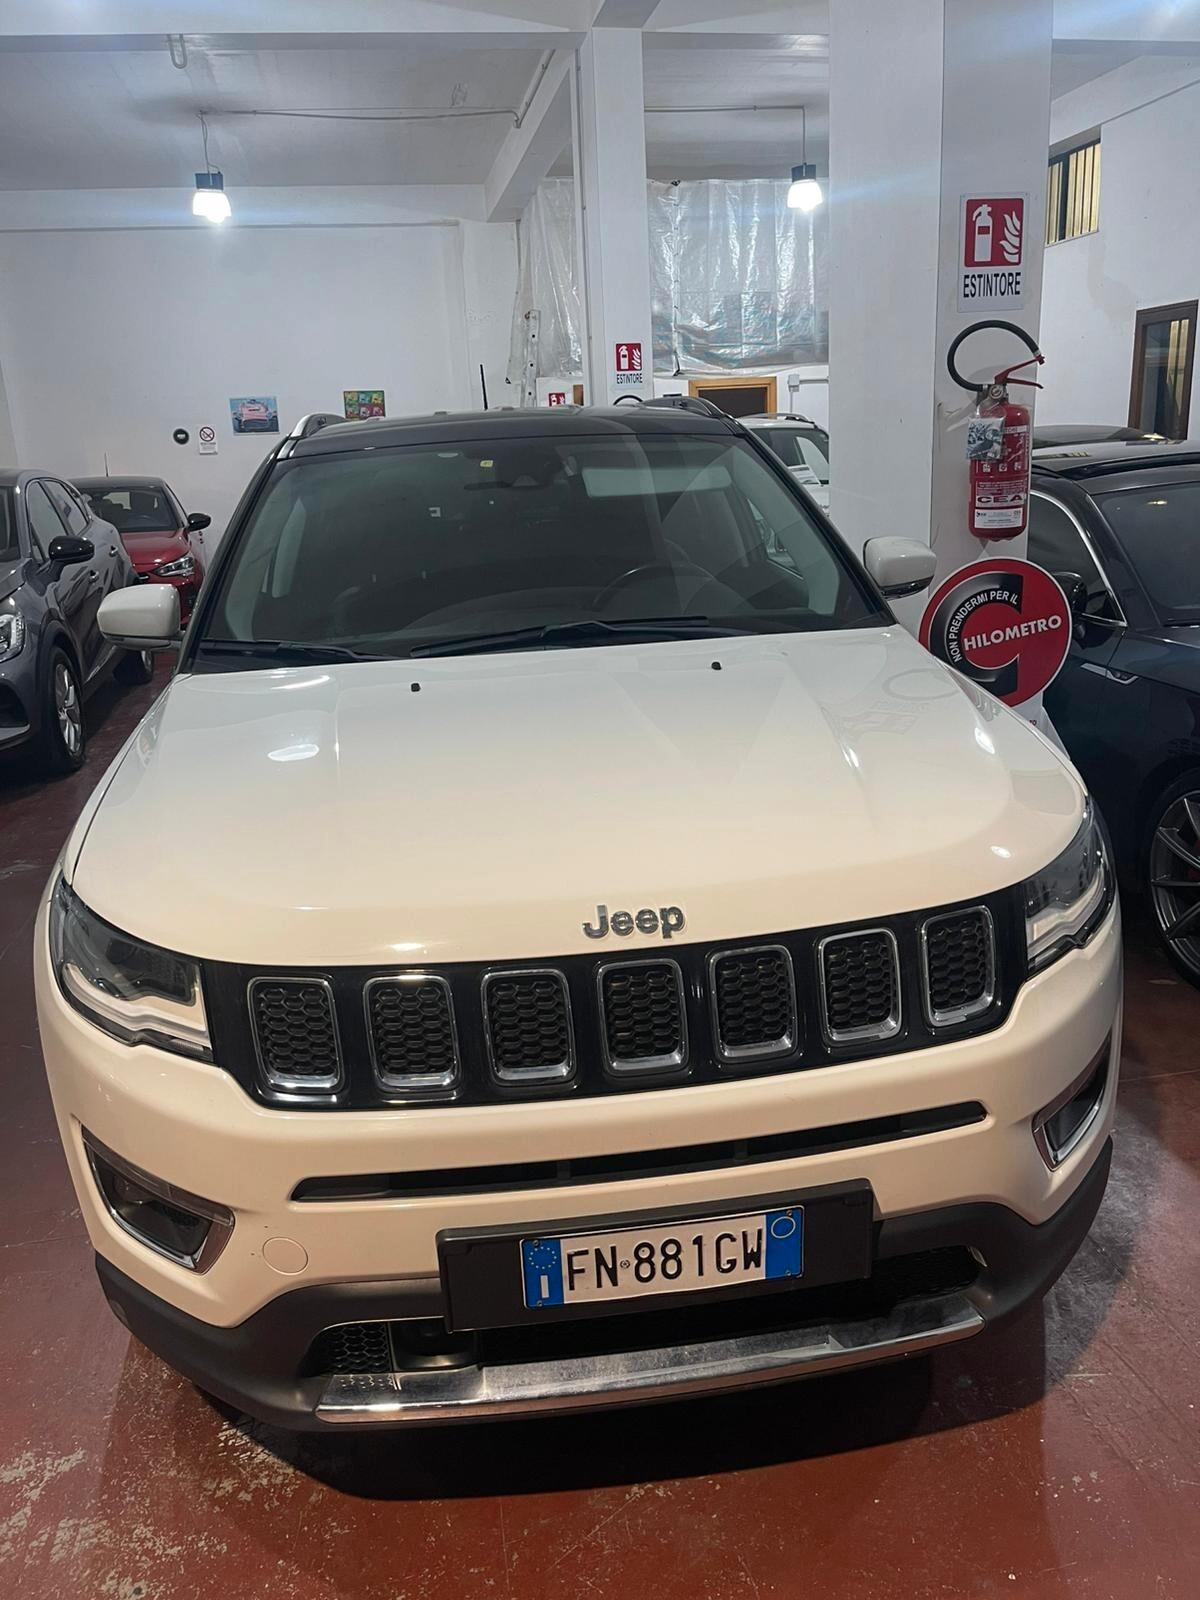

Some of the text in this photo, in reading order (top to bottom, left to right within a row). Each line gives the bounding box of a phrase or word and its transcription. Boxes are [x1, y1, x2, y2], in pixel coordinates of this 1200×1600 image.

[963, 272, 1021, 299] ESTINTORE
[616, 373, 643, 384] ESTINTORE
[948, 590, 1019, 663] NON PRENDERMI PER IL
[963, 614, 1062, 651] HILOMETRO
[582, 904, 685, 939] Jeep
